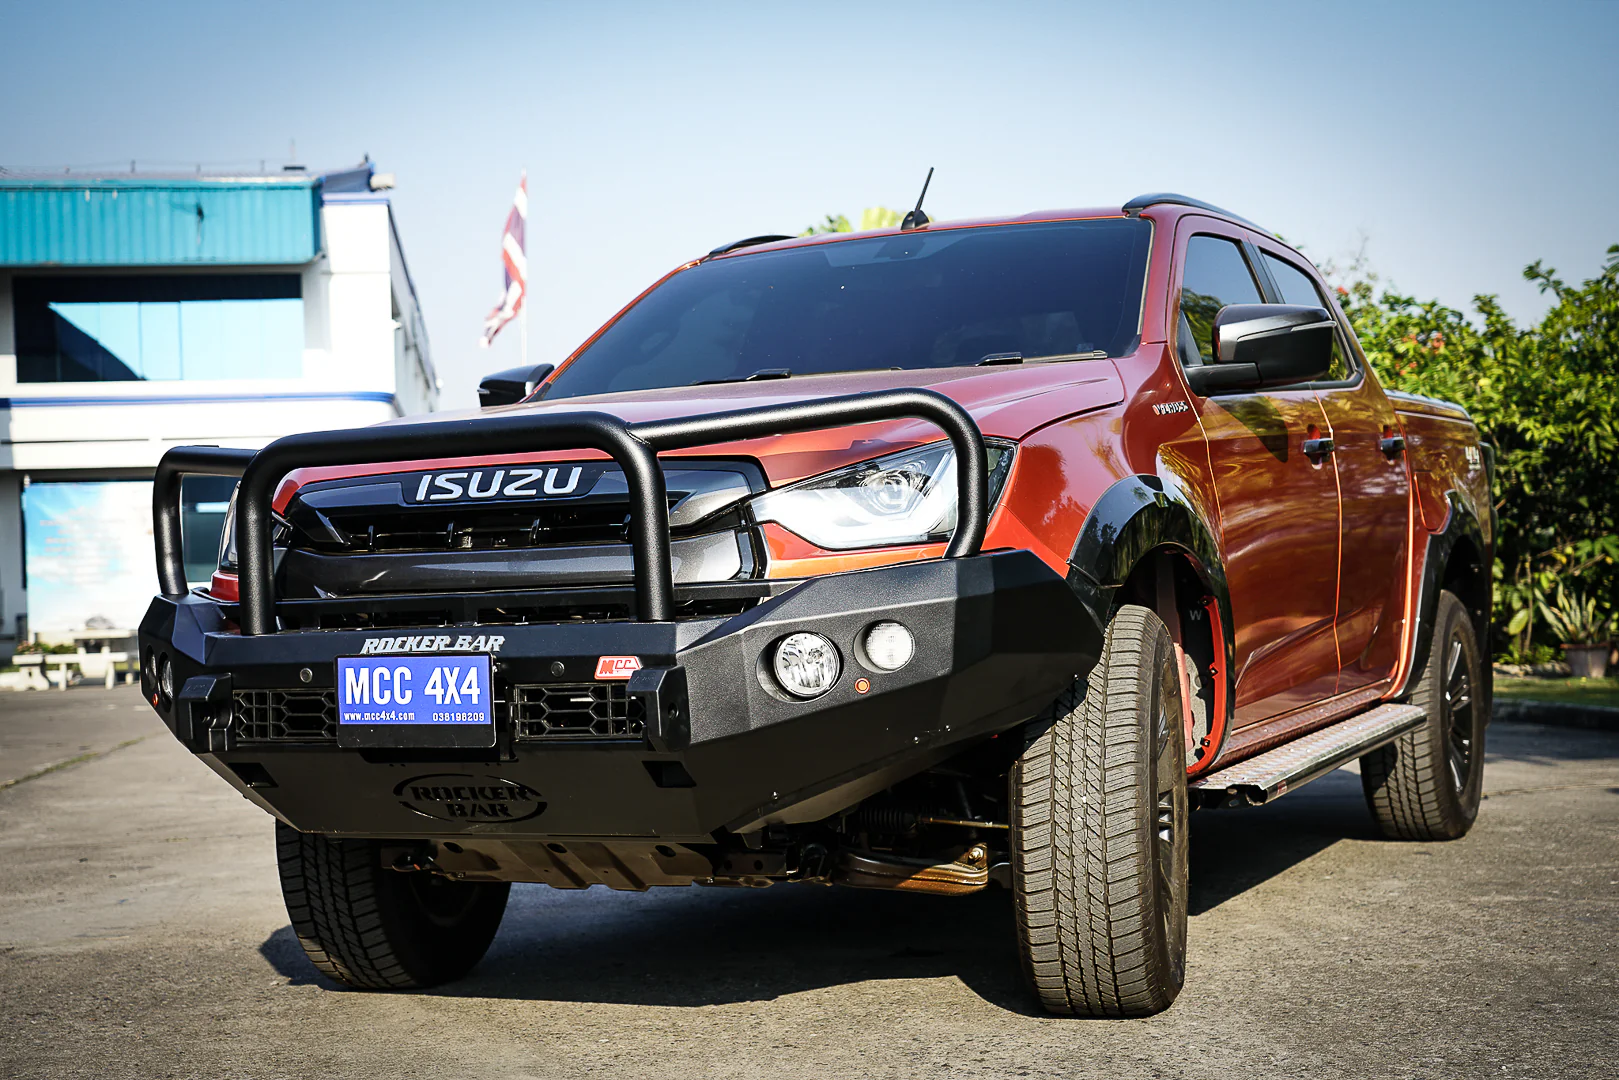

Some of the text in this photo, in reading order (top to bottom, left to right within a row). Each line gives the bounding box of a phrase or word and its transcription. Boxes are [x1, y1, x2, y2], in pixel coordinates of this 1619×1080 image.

[416, 466, 582, 501] ISUZU
[360, 635, 505, 654] ROCKER BAR
[599, 660, 637, 674] MCC
[345, 666, 480, 705] MCC 4X4
[344, 710, 415, 721] www.mcc4x4.com
[432, 712, 485, 722] 038198209
[410, 786, 532, 801] ROCKER
[446, 803, 513, 817] BAR
